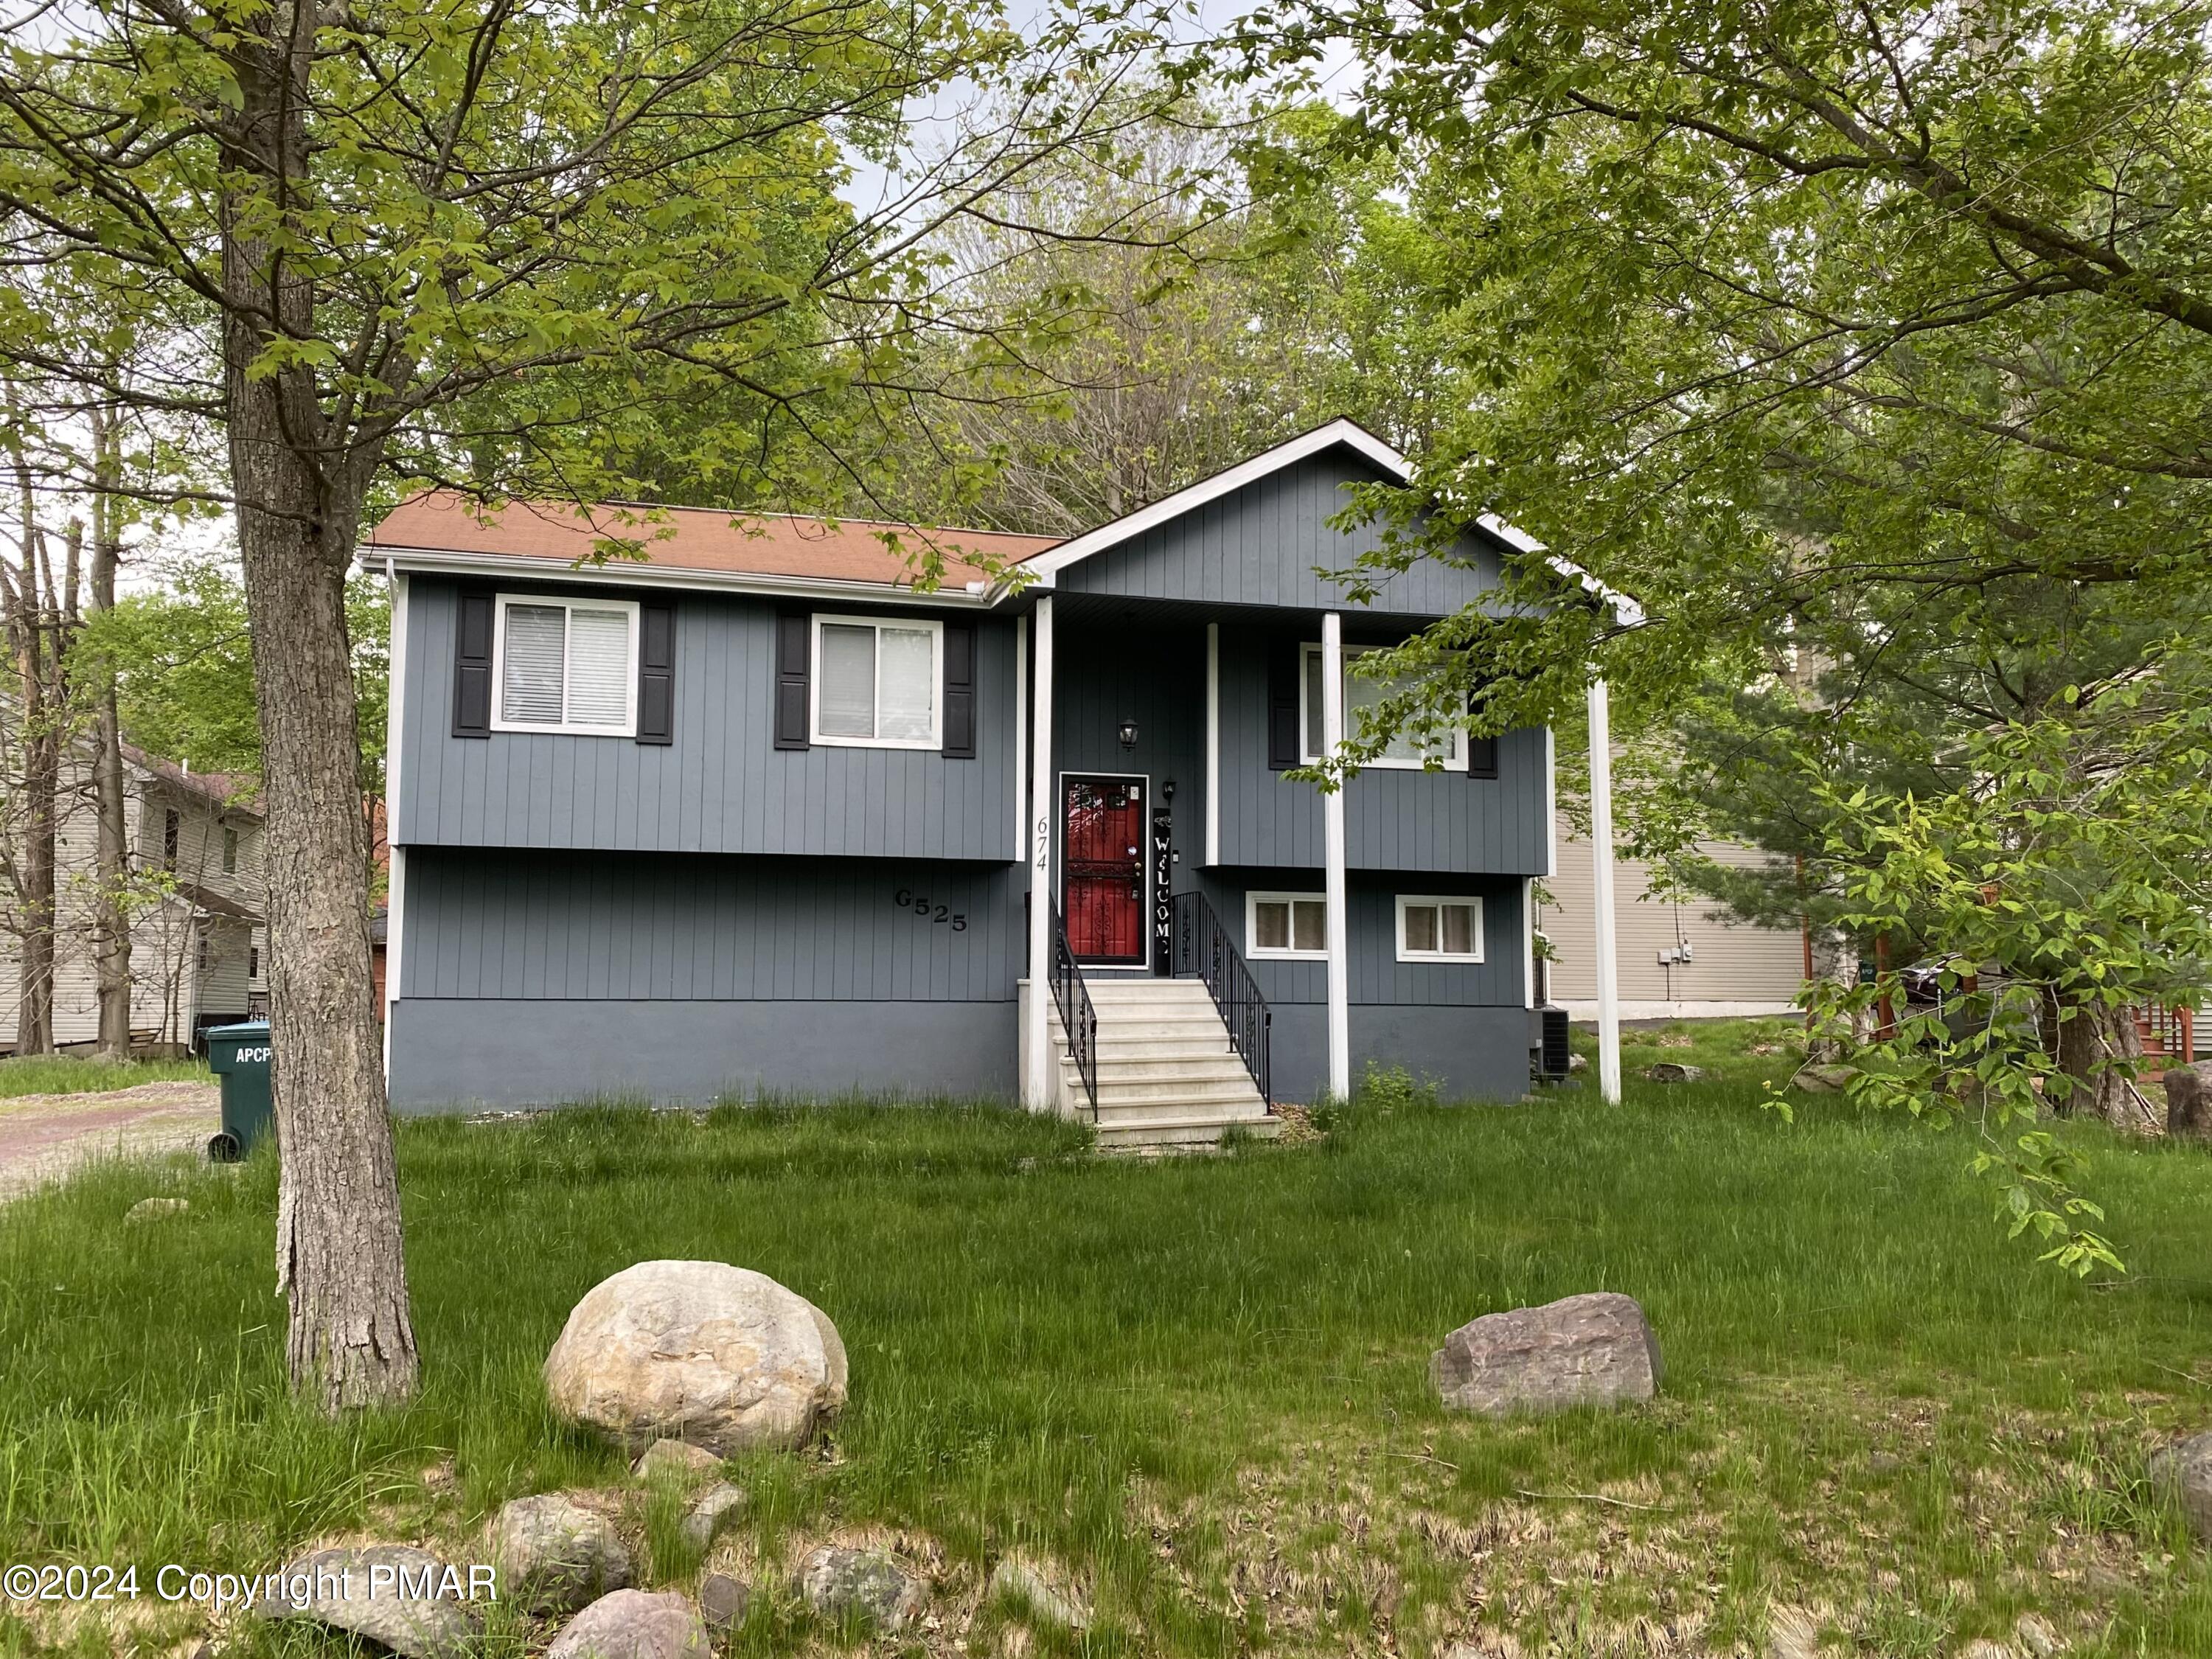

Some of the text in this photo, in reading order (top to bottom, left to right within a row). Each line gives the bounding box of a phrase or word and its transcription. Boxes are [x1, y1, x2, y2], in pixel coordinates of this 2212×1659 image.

[1037, 816, 1047, 871] 674
[895, 889, 967, 932] G525
[236, 1047, 271, 1062] APCP
